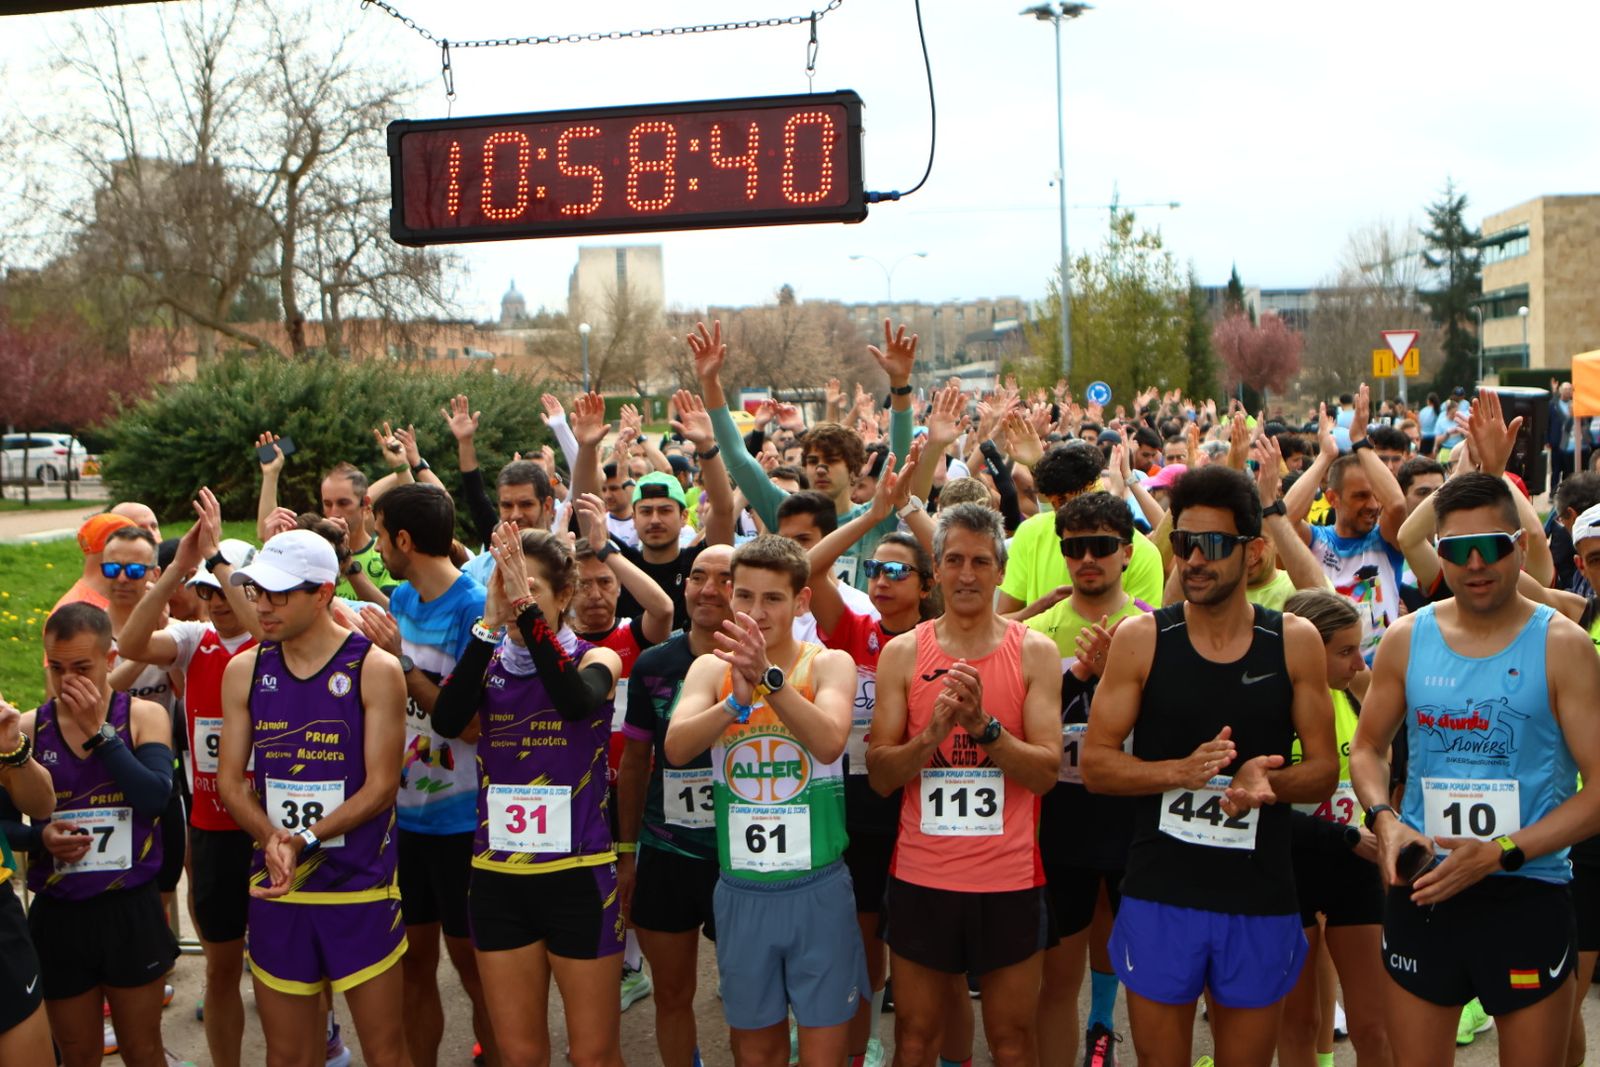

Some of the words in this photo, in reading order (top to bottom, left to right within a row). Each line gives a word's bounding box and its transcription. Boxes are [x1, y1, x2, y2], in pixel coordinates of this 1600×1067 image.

[447, 111, 836, 221] 10:58:40
[530, 721, 563, 731] PRIM
[305, 731, 340, 744] PRIM
[522, 736, 568, 747] Macotera
[297, 748, 345, 761] Macotera
[952, 750, 978, 766] CLUB
[731, 759, 803, 781] ALCER
[90, 791, 124, 805] PRIM
[928, 787, 998, 818] 113
[281, 799, 324, 829] 38
[505, 804, 547, 834] 31
[1443, 801, 1497, 837] 10
[745, 823, 787, 854] 61
[1390, 953, 1418, 973] CIVI
